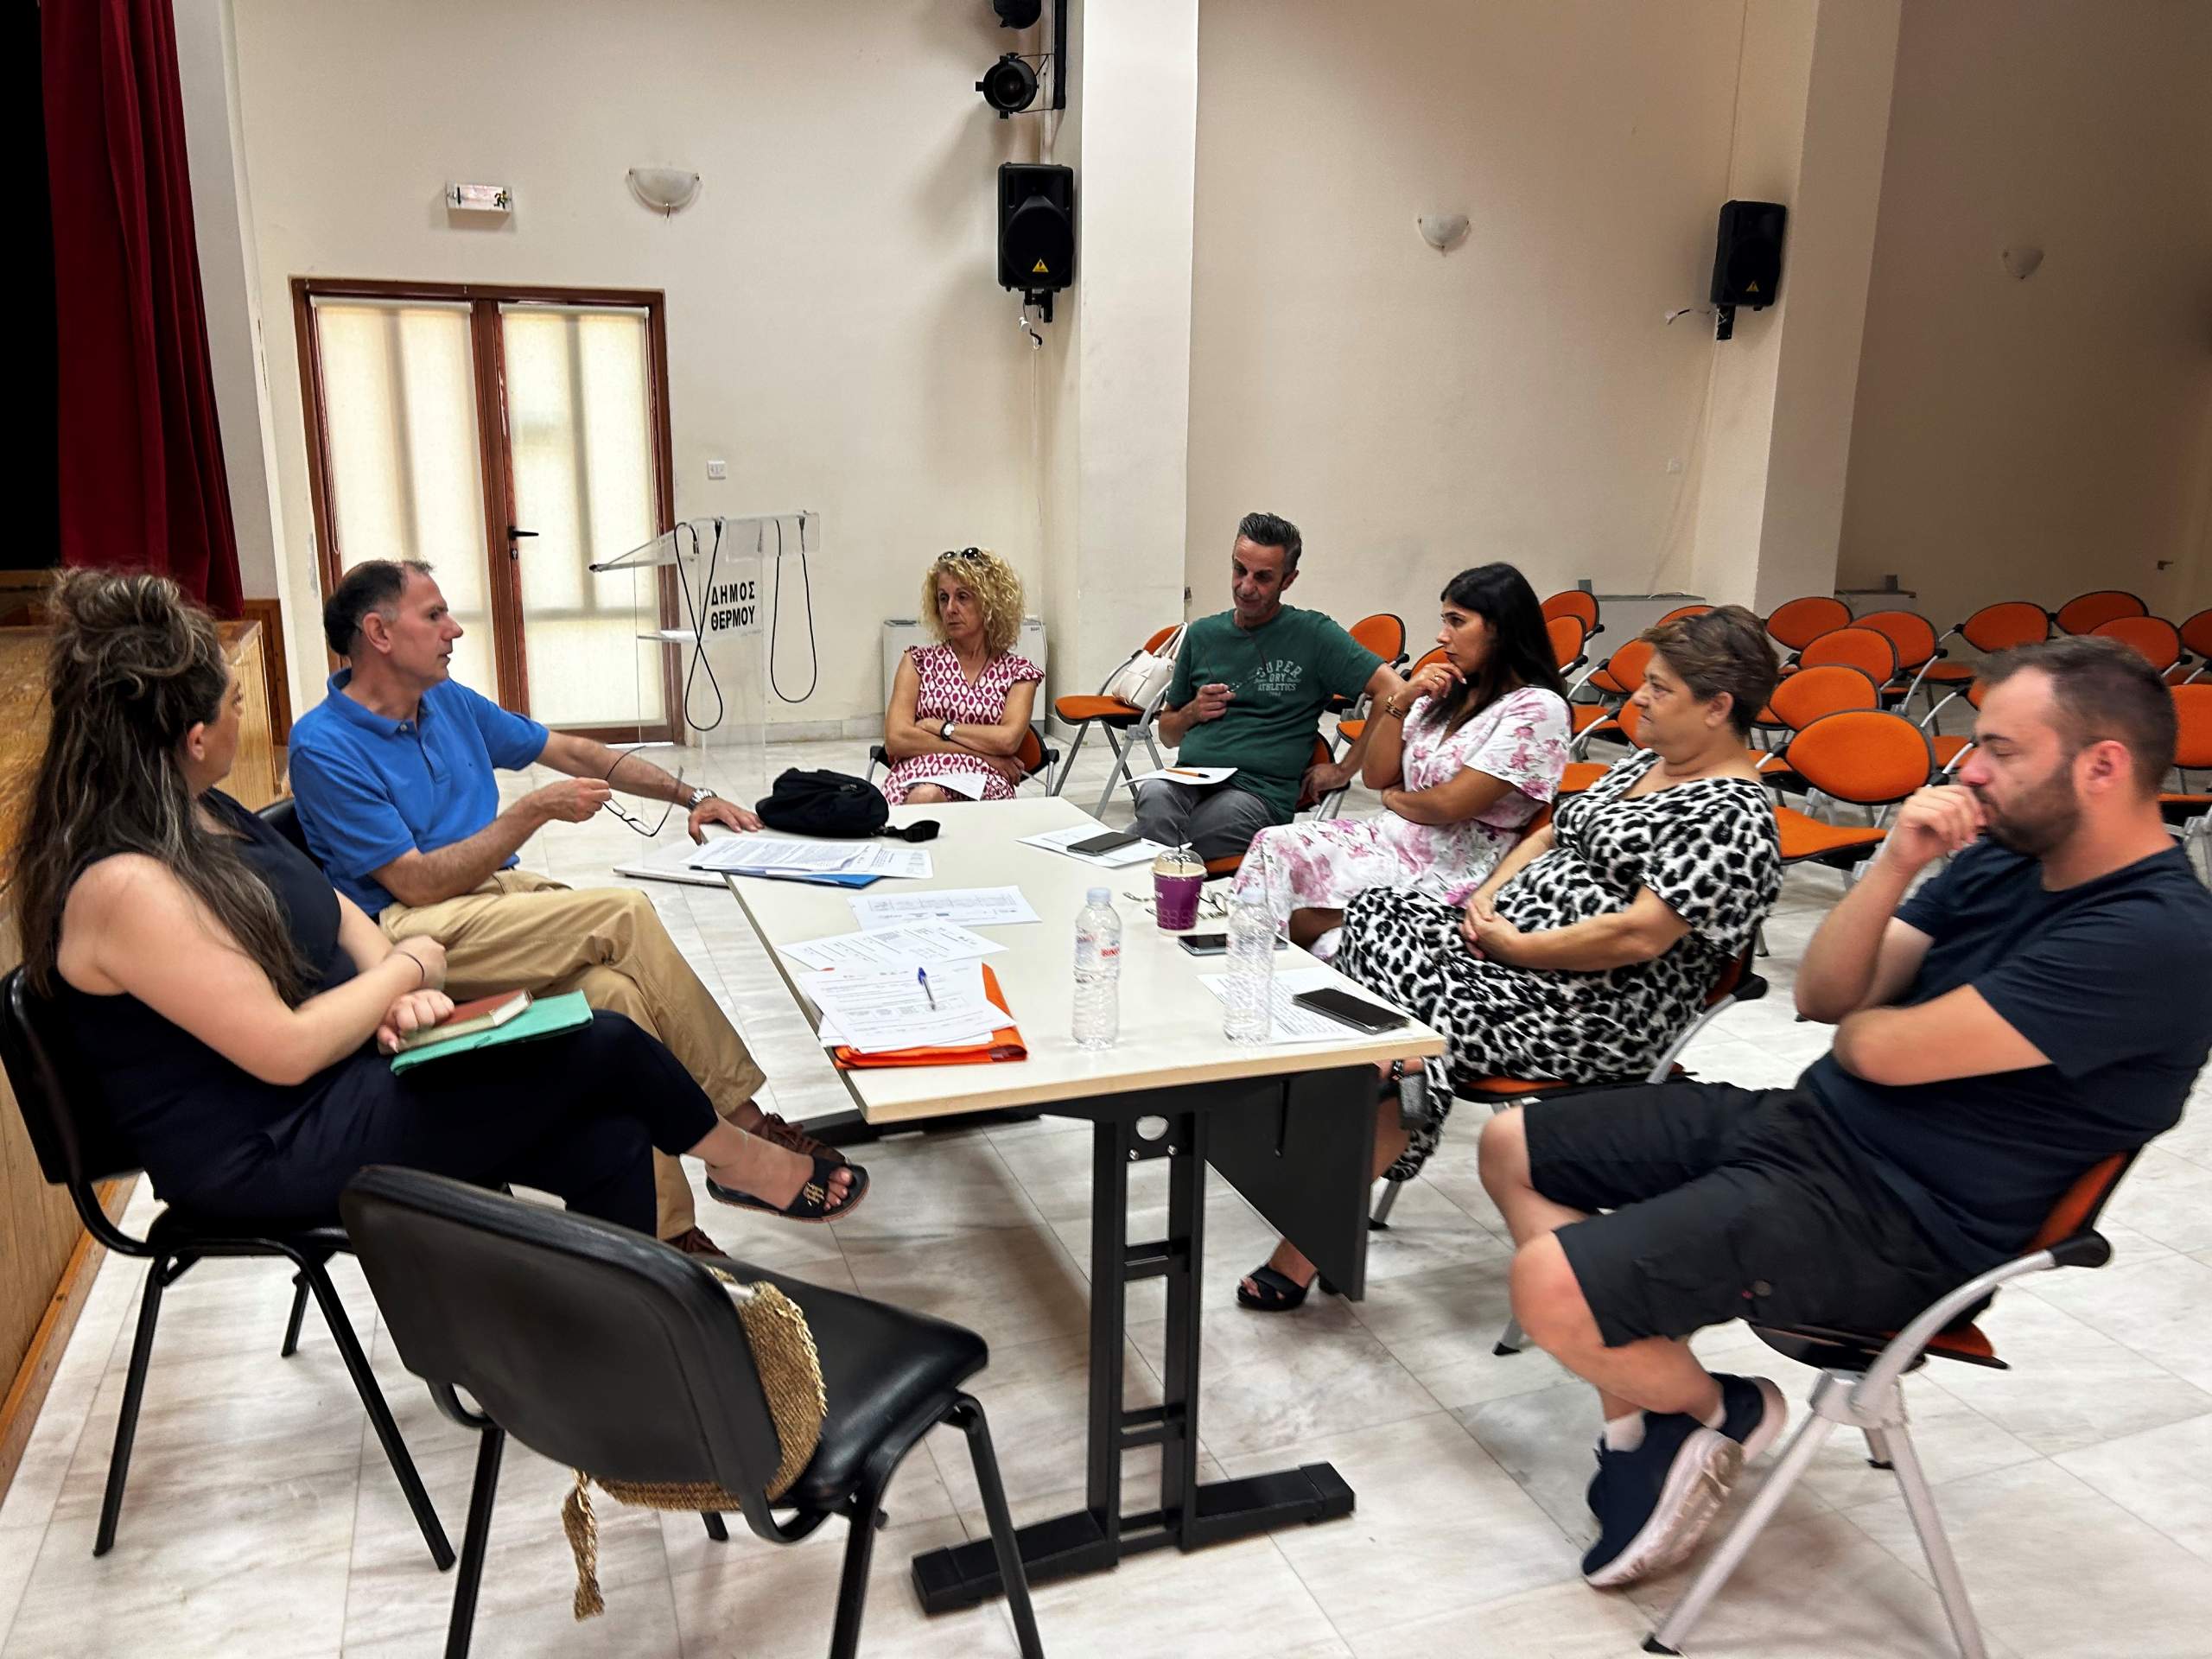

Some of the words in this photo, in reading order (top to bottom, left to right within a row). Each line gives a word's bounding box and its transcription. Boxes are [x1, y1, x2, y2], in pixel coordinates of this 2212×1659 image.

[711, 581, 754, 606] ΔΗΜΟΣ
[711, 605, 754, 631] ΘΕΡΜΟΥ
[1256, 659, 1302, 678] SUPER
[1269, 673, 1286, 683] DRY
